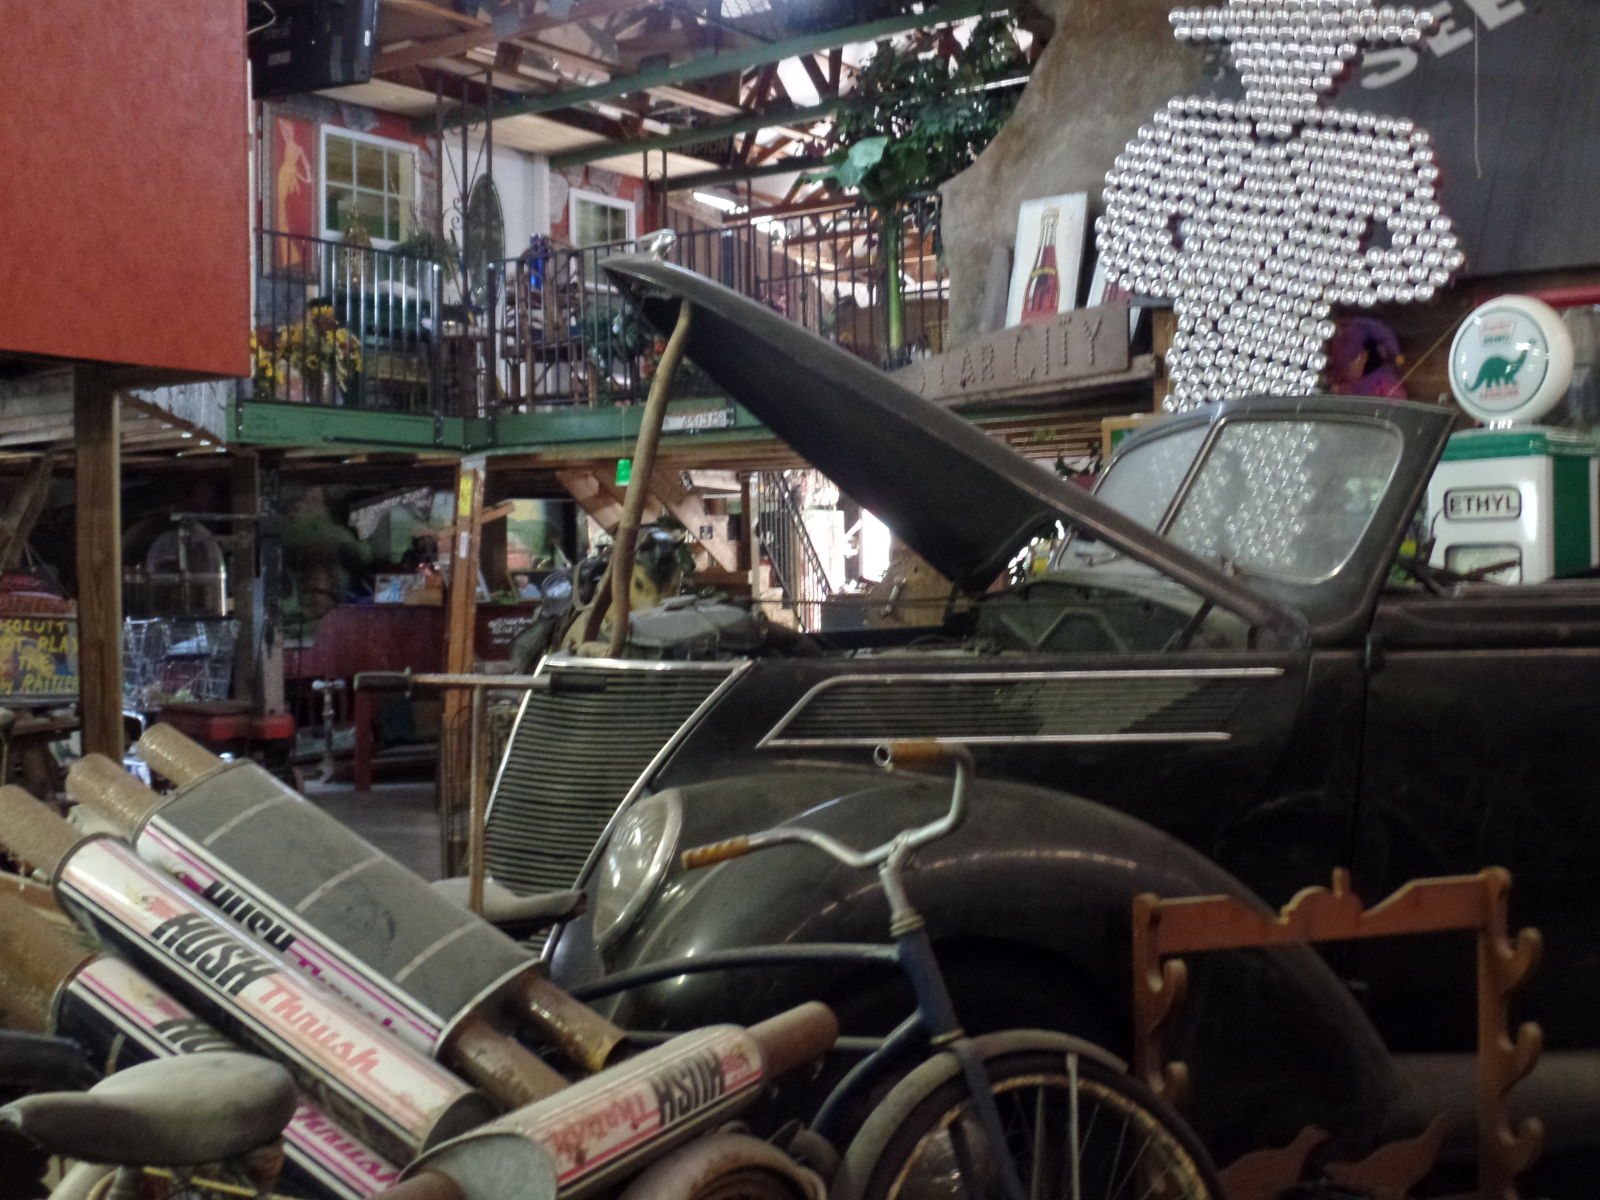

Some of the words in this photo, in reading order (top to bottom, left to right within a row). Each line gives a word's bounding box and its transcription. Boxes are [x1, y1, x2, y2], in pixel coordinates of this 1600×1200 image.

[1012, 314, 1103, 384] CITY
[1449, 493, 1519, 513] ETHYL
[151, 911, 280, 997] HUSH
[258, 982, 381, 1074] Thrush
[648, 1049, 727, 1129] HUSH
